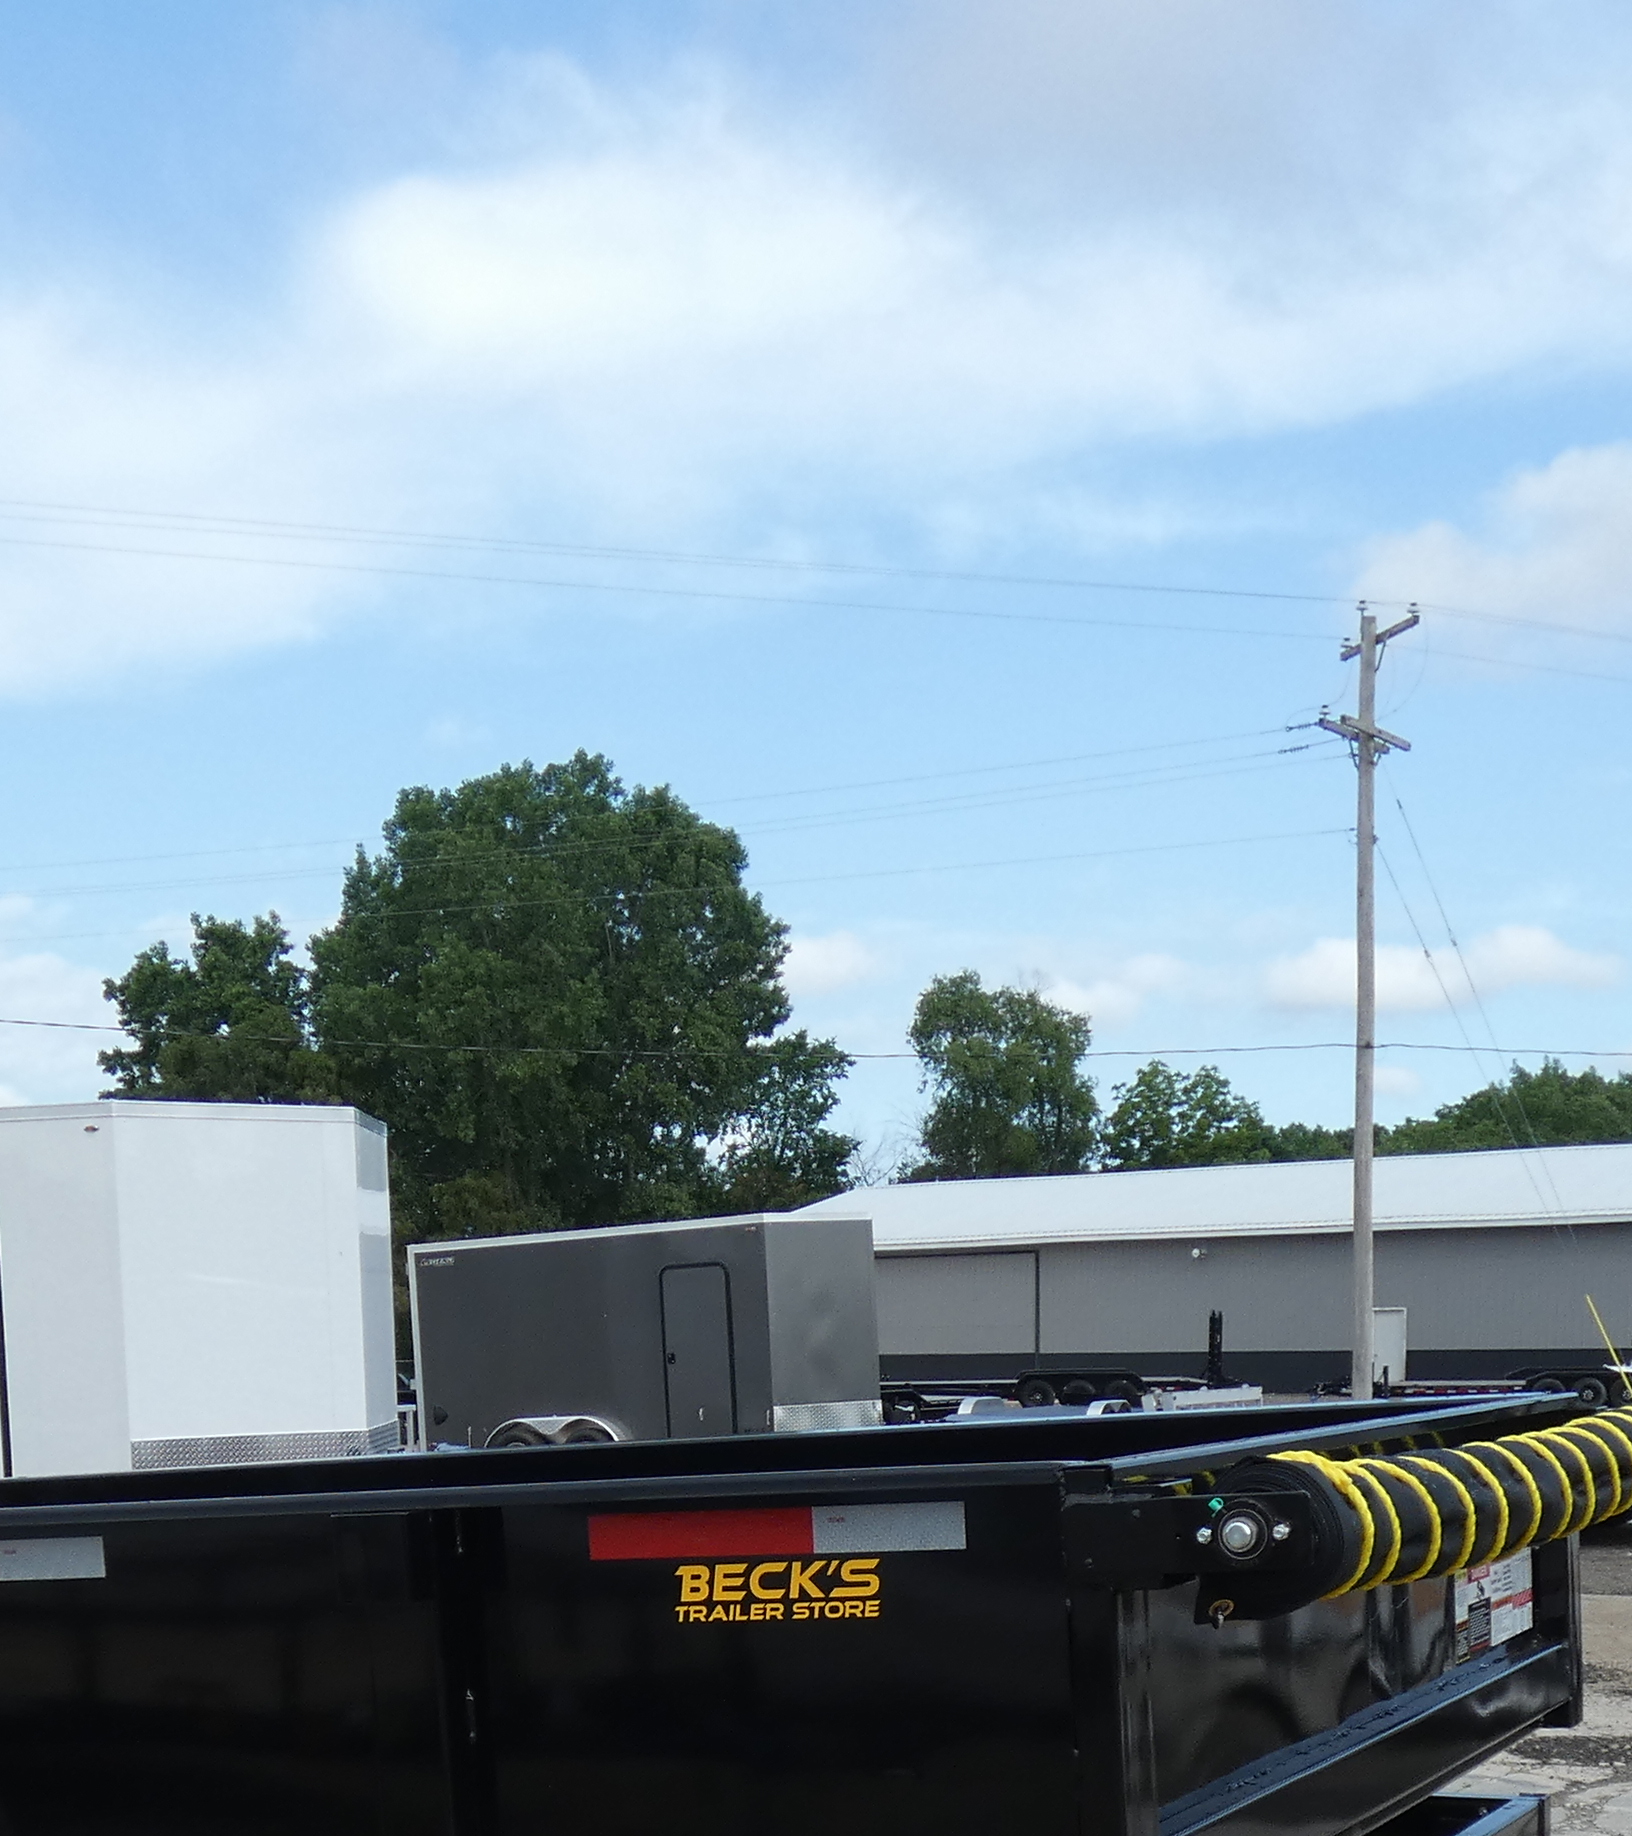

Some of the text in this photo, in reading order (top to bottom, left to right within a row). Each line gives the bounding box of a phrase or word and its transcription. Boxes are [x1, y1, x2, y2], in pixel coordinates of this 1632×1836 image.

[674, 1558, 880, 1603] BECK'S
[674, 1600, 880, 1624] TRAILER STORE
